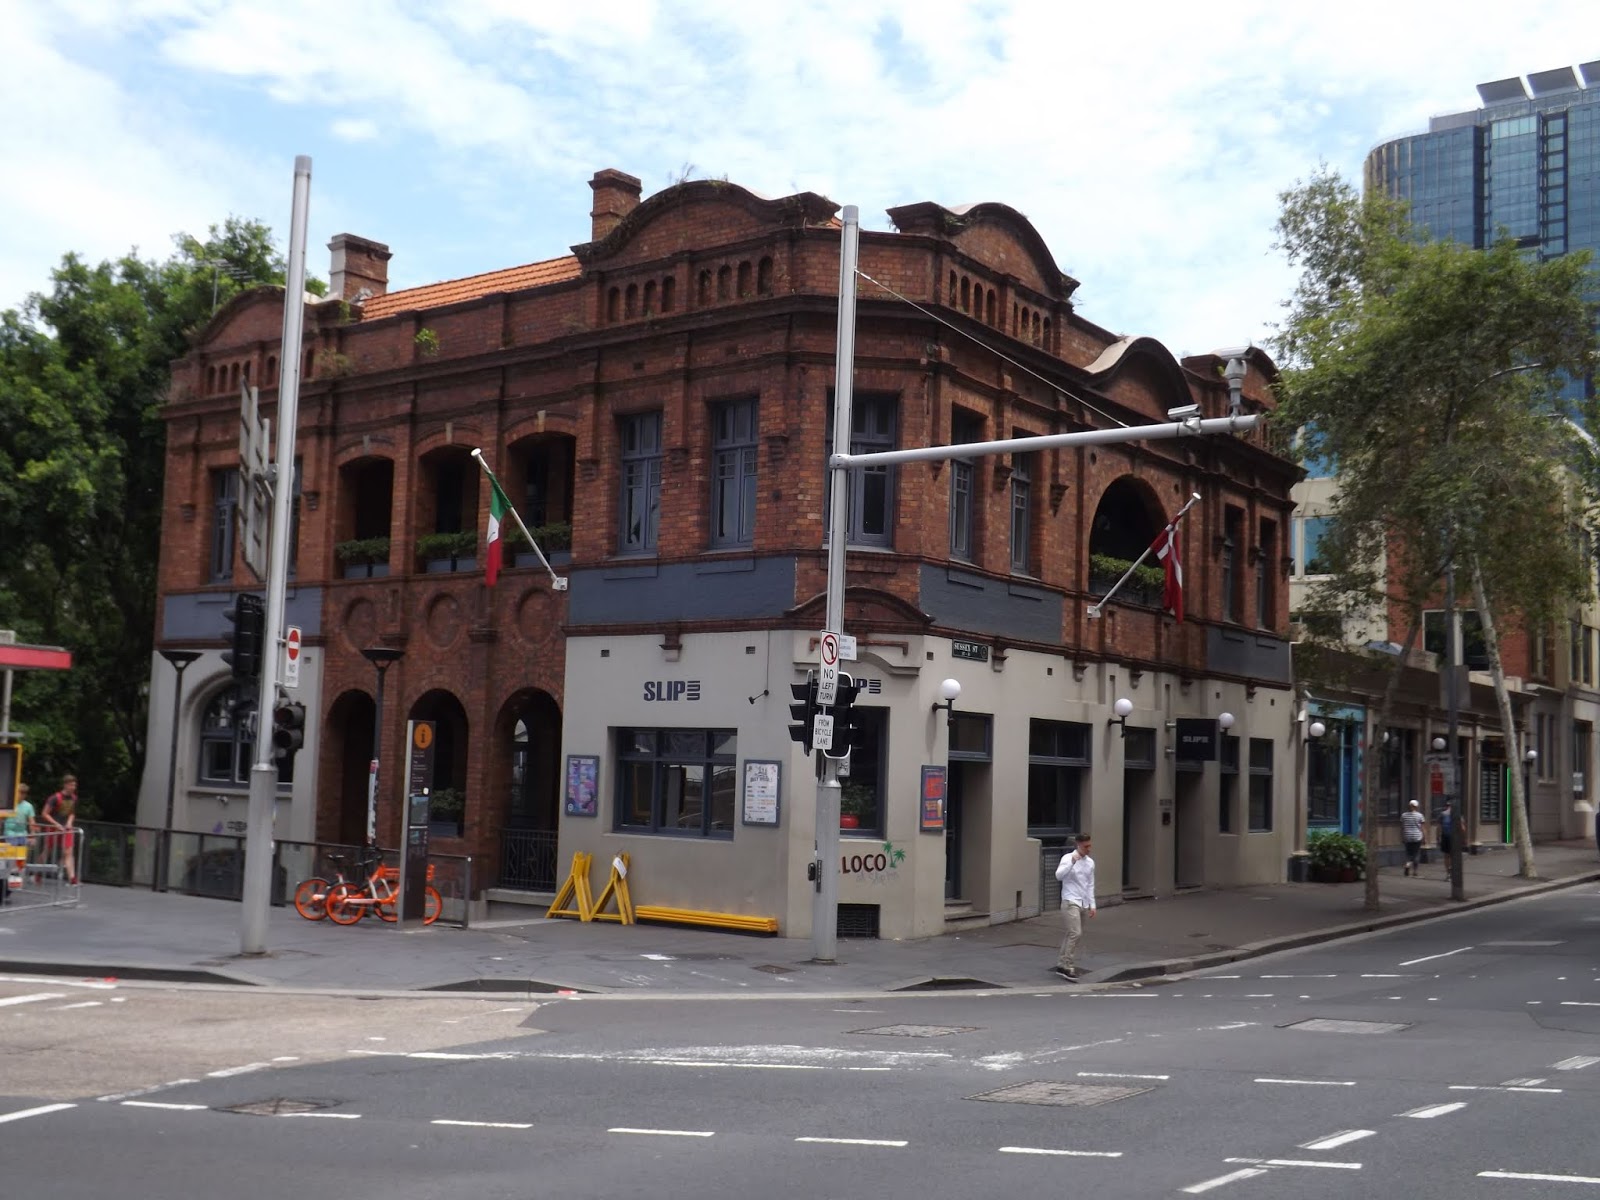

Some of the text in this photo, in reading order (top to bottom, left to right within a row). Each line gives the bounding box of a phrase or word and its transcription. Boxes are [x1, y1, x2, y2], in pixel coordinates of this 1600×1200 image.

[823, 668, 834, 680] NO
[643, 681, 686, 702] SLIP
[821, 682, 834, 691] LEFT
[819, 691, 833, 701] TURN
[818, 718, 830, 727] FROM
[815, 727, 832, 737] BICYCLE
[817, 737, 828, 746] LANE
[842, 853, 887, 874] LOCO
